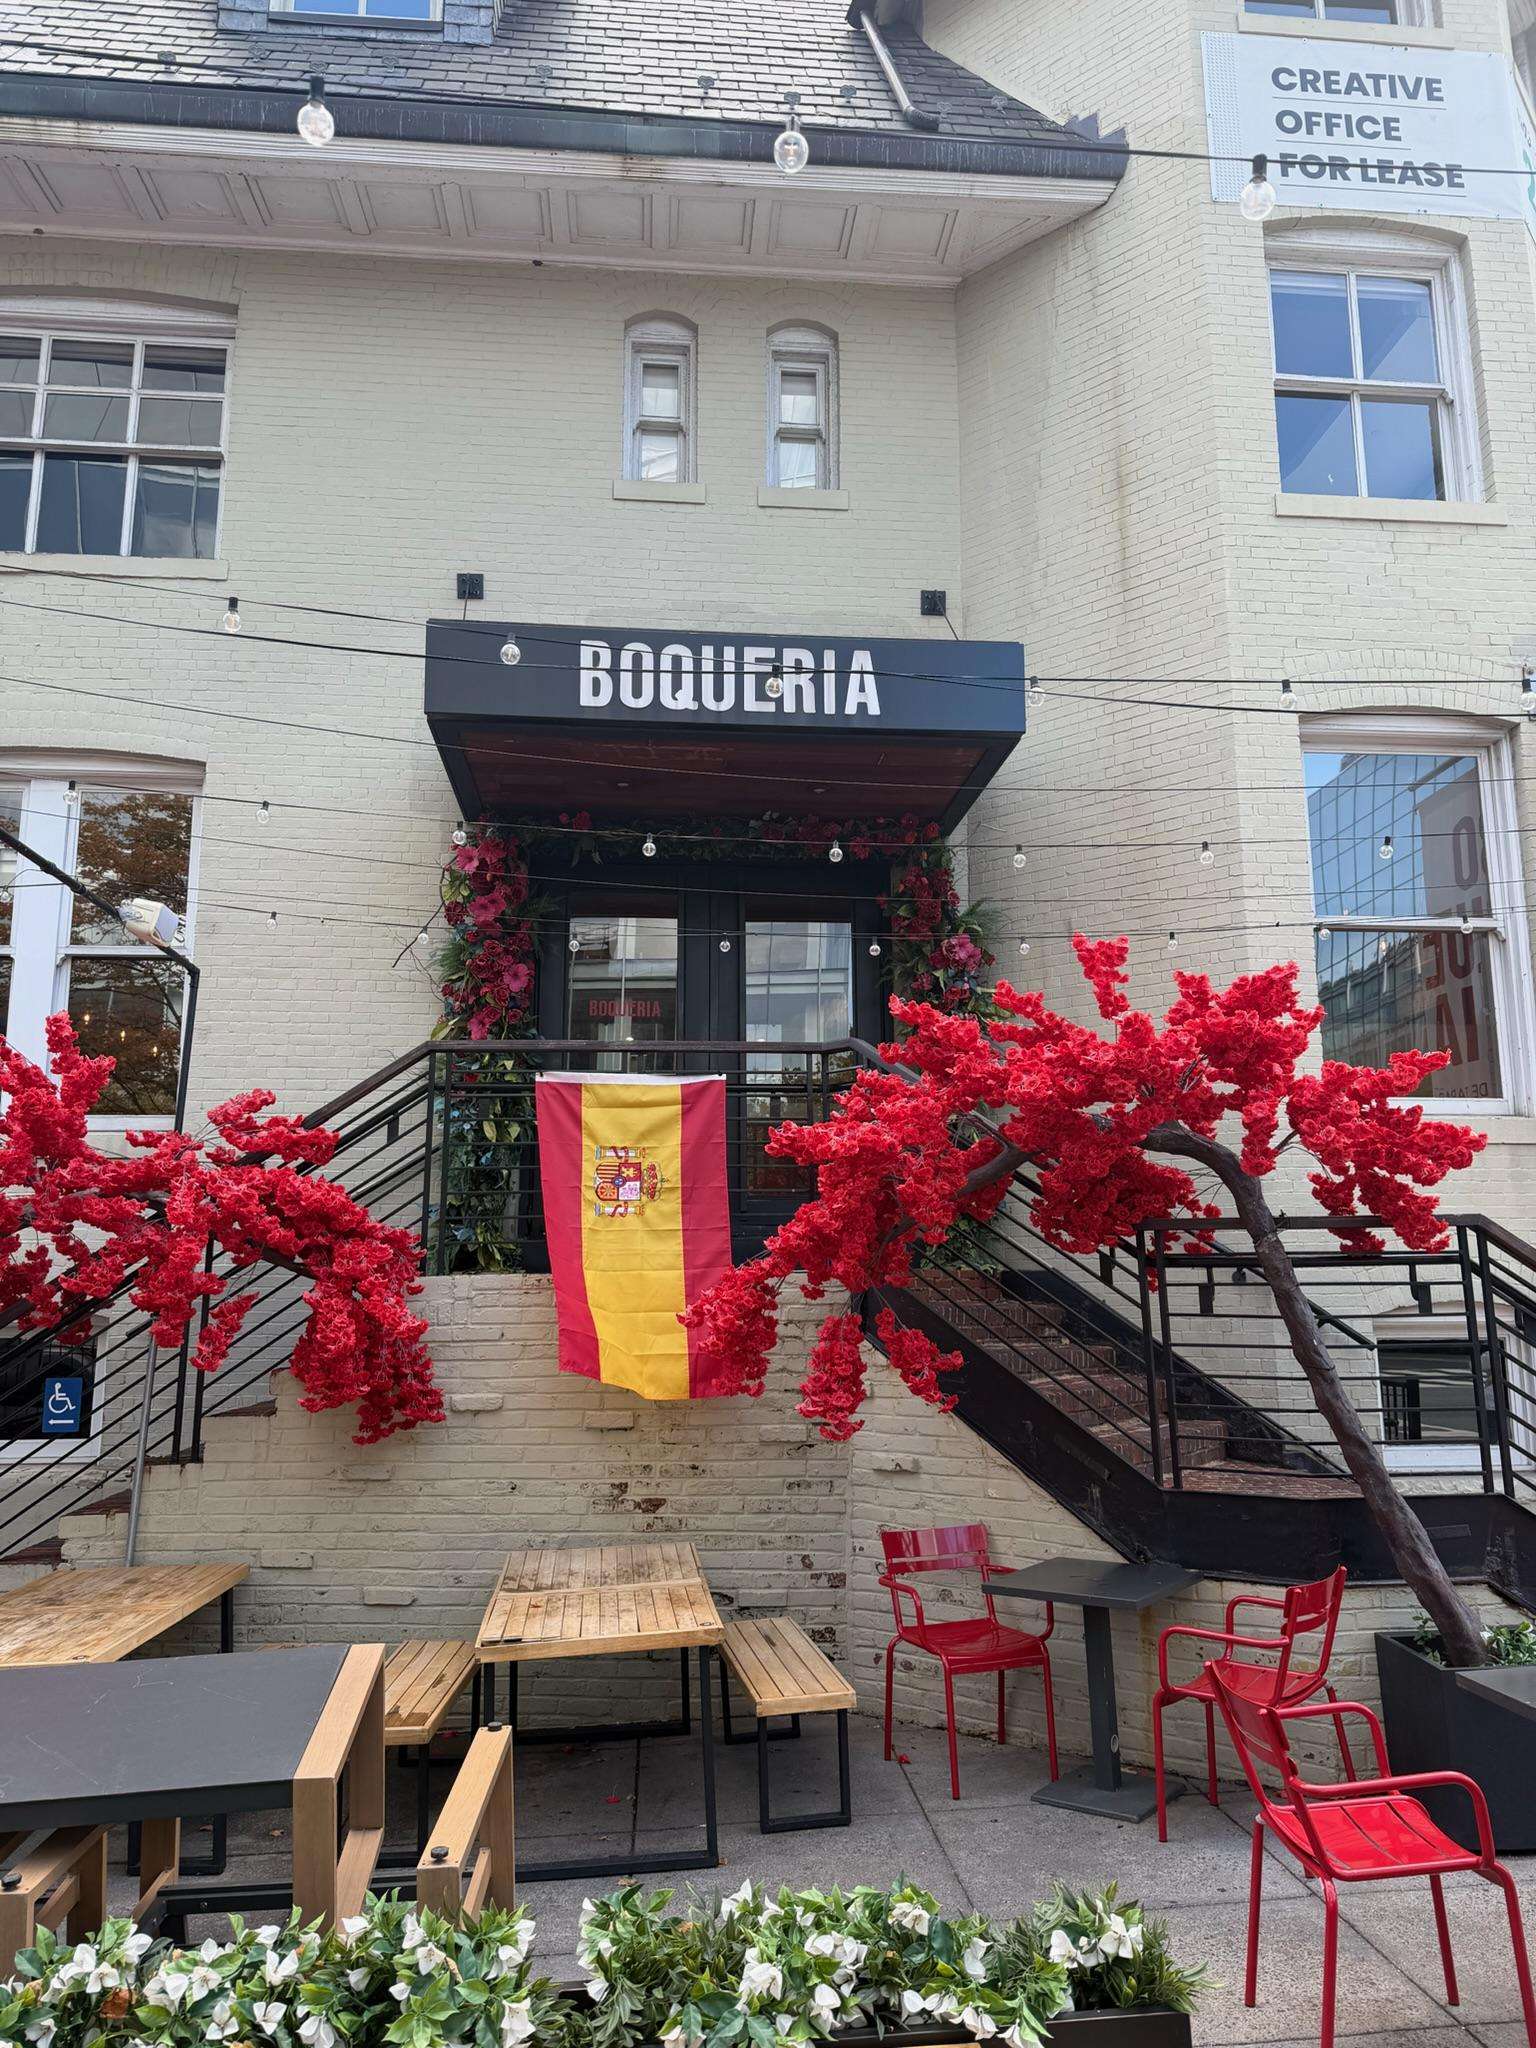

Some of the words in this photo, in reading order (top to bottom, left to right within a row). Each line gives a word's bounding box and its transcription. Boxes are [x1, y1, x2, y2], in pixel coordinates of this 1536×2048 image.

[1271, 67, 1444, 101] CREATIVE
[1275, 109, 1402, 141] OFFICE
[1279, 152, 1352, 181] FOR
[1360, 157, 1465, 188] LEASE
[579, 640, 881, 715] BOQUERIA
